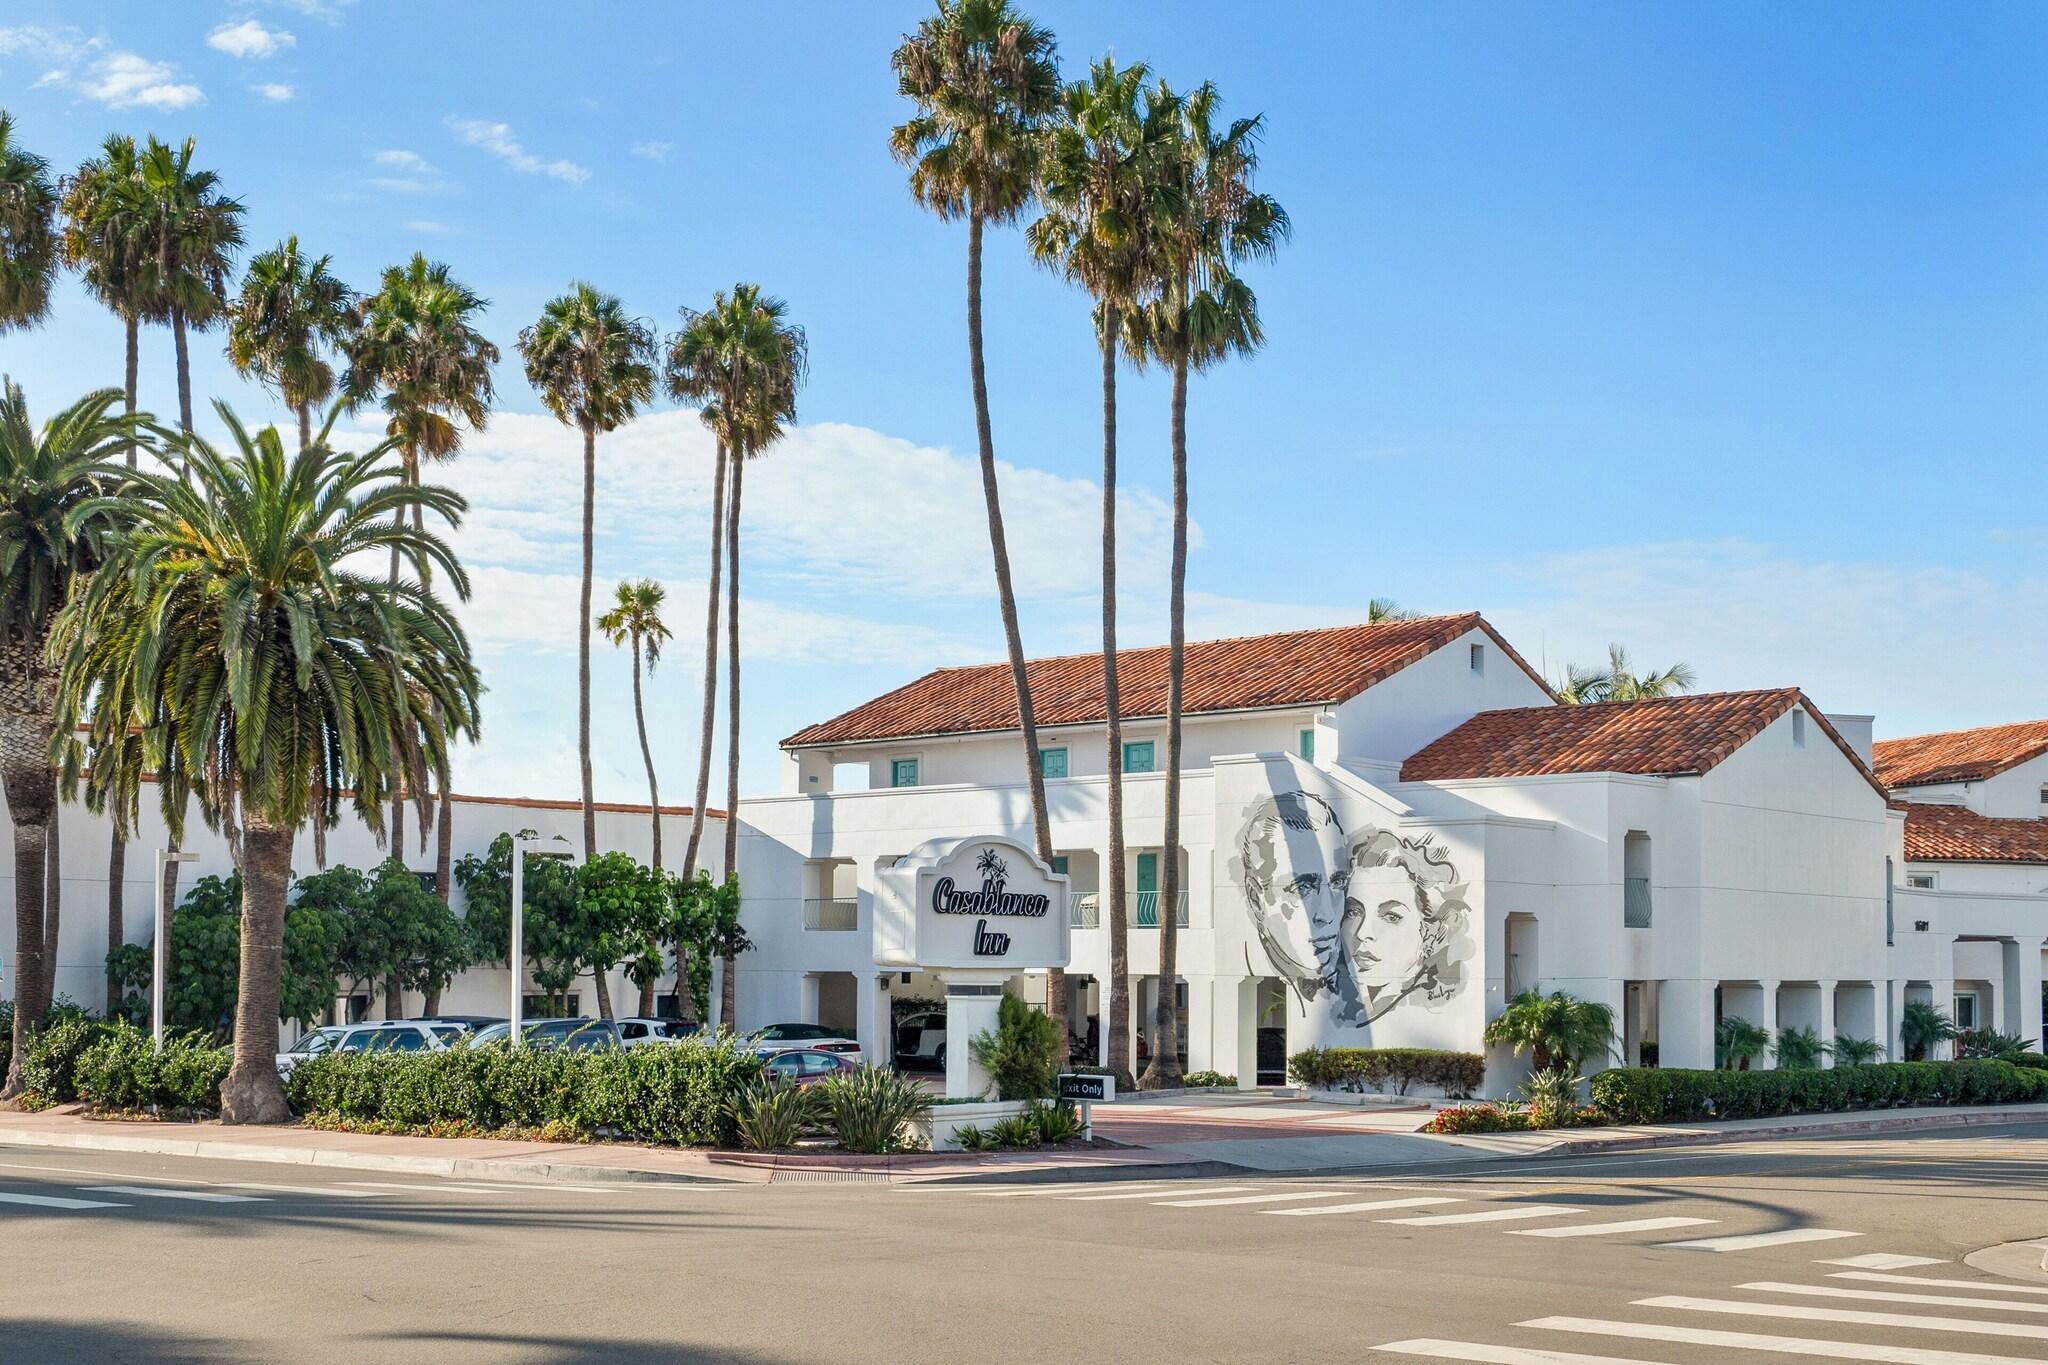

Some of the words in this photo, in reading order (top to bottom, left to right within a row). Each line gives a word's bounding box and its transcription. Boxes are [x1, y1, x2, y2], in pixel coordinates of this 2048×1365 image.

[932, 876, 1050, 917] Casablanca
[973, 919, 1011, 955] Inn
[1064, 1083, 1079, 1093] xit
[1081, 1084, 1102, 1096] Only
